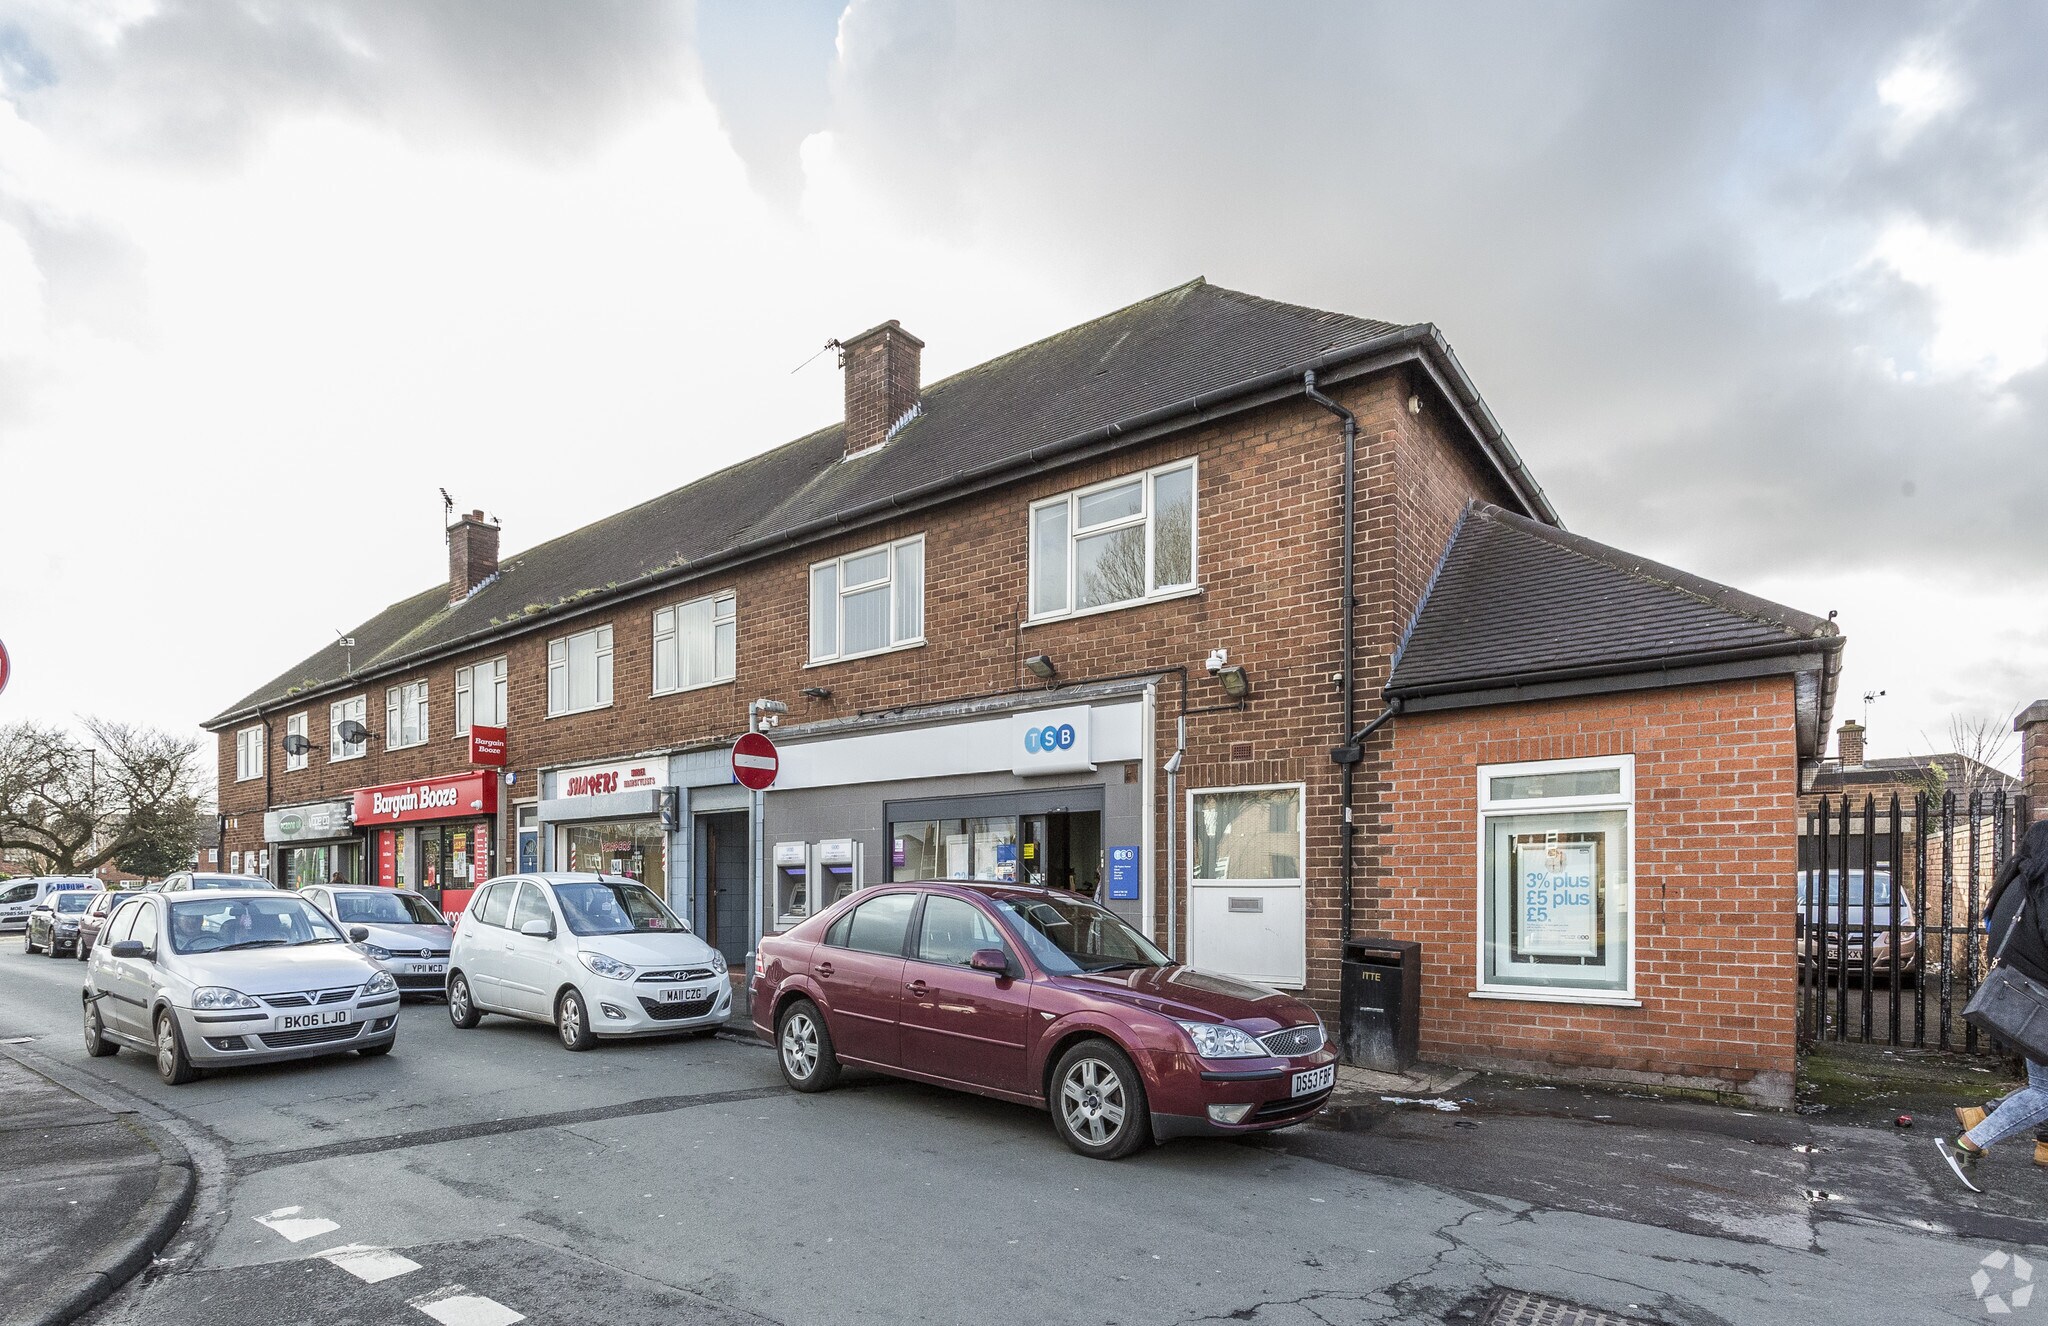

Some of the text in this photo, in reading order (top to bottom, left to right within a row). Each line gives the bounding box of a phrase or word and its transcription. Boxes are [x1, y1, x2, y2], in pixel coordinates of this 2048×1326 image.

[474, 738, 505, 748] Bargain
[1028, 728, 1072, 749] TSB
[478, 746, 501, 754] Booze
[567, 771, 618, 796] SHAPERS
[372, 787, 418, 819] Bargain
[419, 785, 458, 809] Booze
[1114, 850, 1133, 859] TSB
[1526, 872, 1590, 891] 3% plus
[1526, 890, 1590, 908] £5 plus
[1526, 907, 1552, 922] £5.
[412, 964, 426, 972] YP11
[667, 989, 702, 1001] MA11 CZG
[284, 1014, 319, 1029] BK06
[1295, 1071, 1319, 1093] DS53
